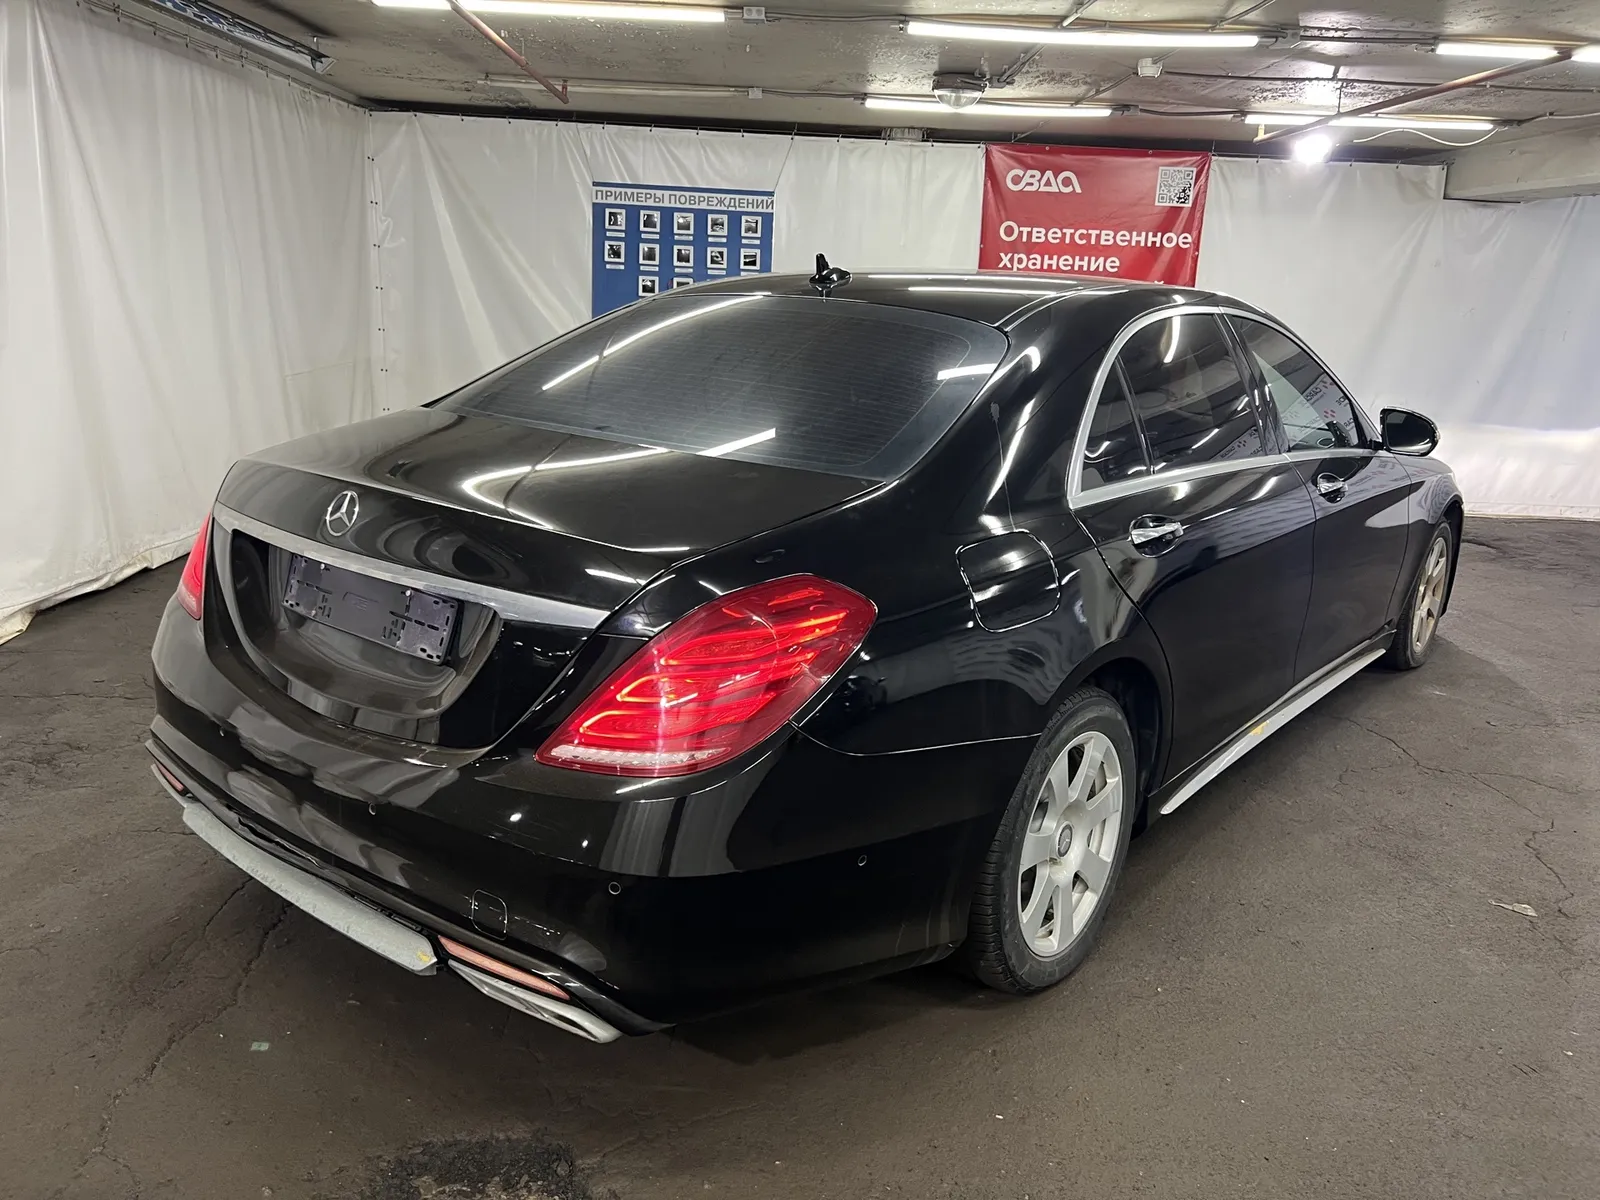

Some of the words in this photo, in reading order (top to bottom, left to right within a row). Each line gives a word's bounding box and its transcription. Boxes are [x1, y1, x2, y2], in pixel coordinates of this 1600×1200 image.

[595, 189, 665, 204] ПРИМЕРЫ
[668, 193, 775, 210] ПОВРЕЖДЕНИЙ
[999, 220, 1193, 249] Ответственное
[998, 251, 1121, 272] хранение
